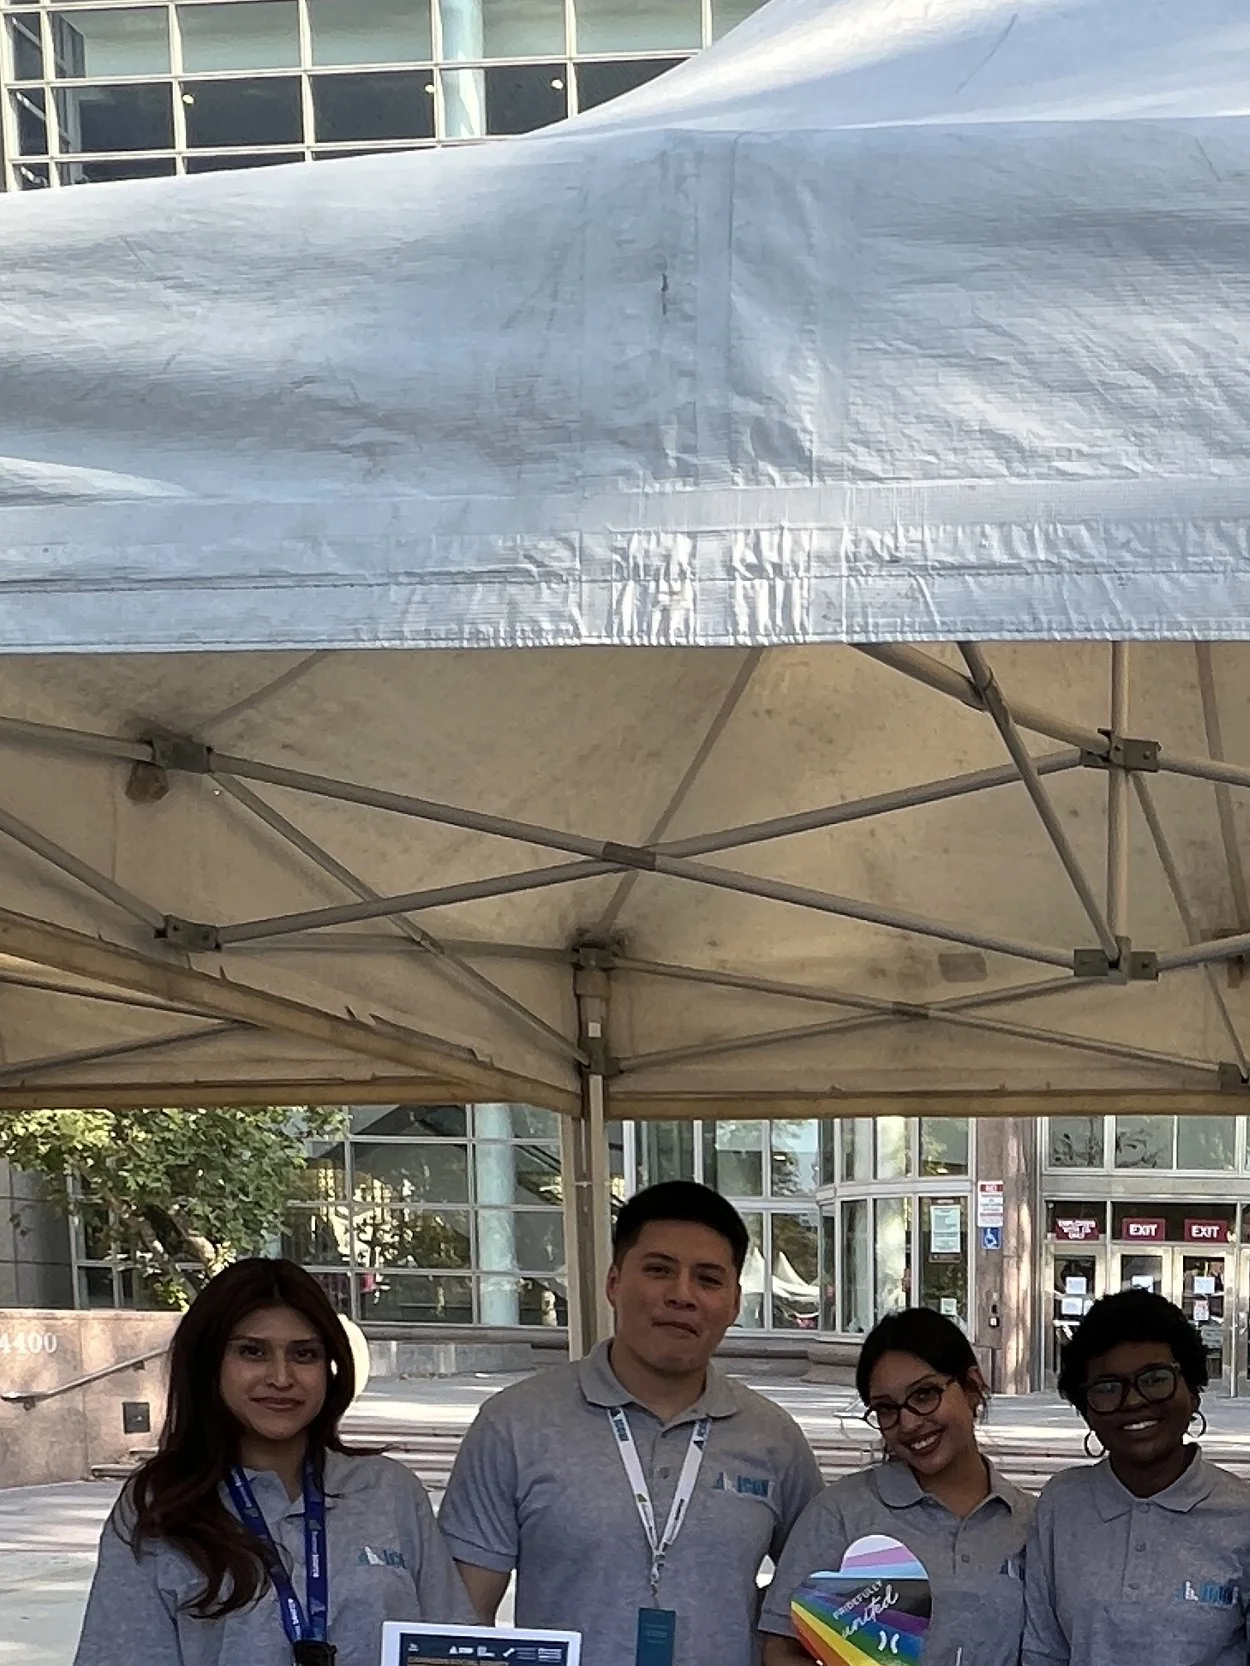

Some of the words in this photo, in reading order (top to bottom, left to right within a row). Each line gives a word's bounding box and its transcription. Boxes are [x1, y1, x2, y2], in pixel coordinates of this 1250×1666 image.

[1129, 1224, 1157, 1236] EXIT
[1191, 1225, 1219, 1238] EXIT
[833, 1579, 884, 1620] PRIDEFULLY
